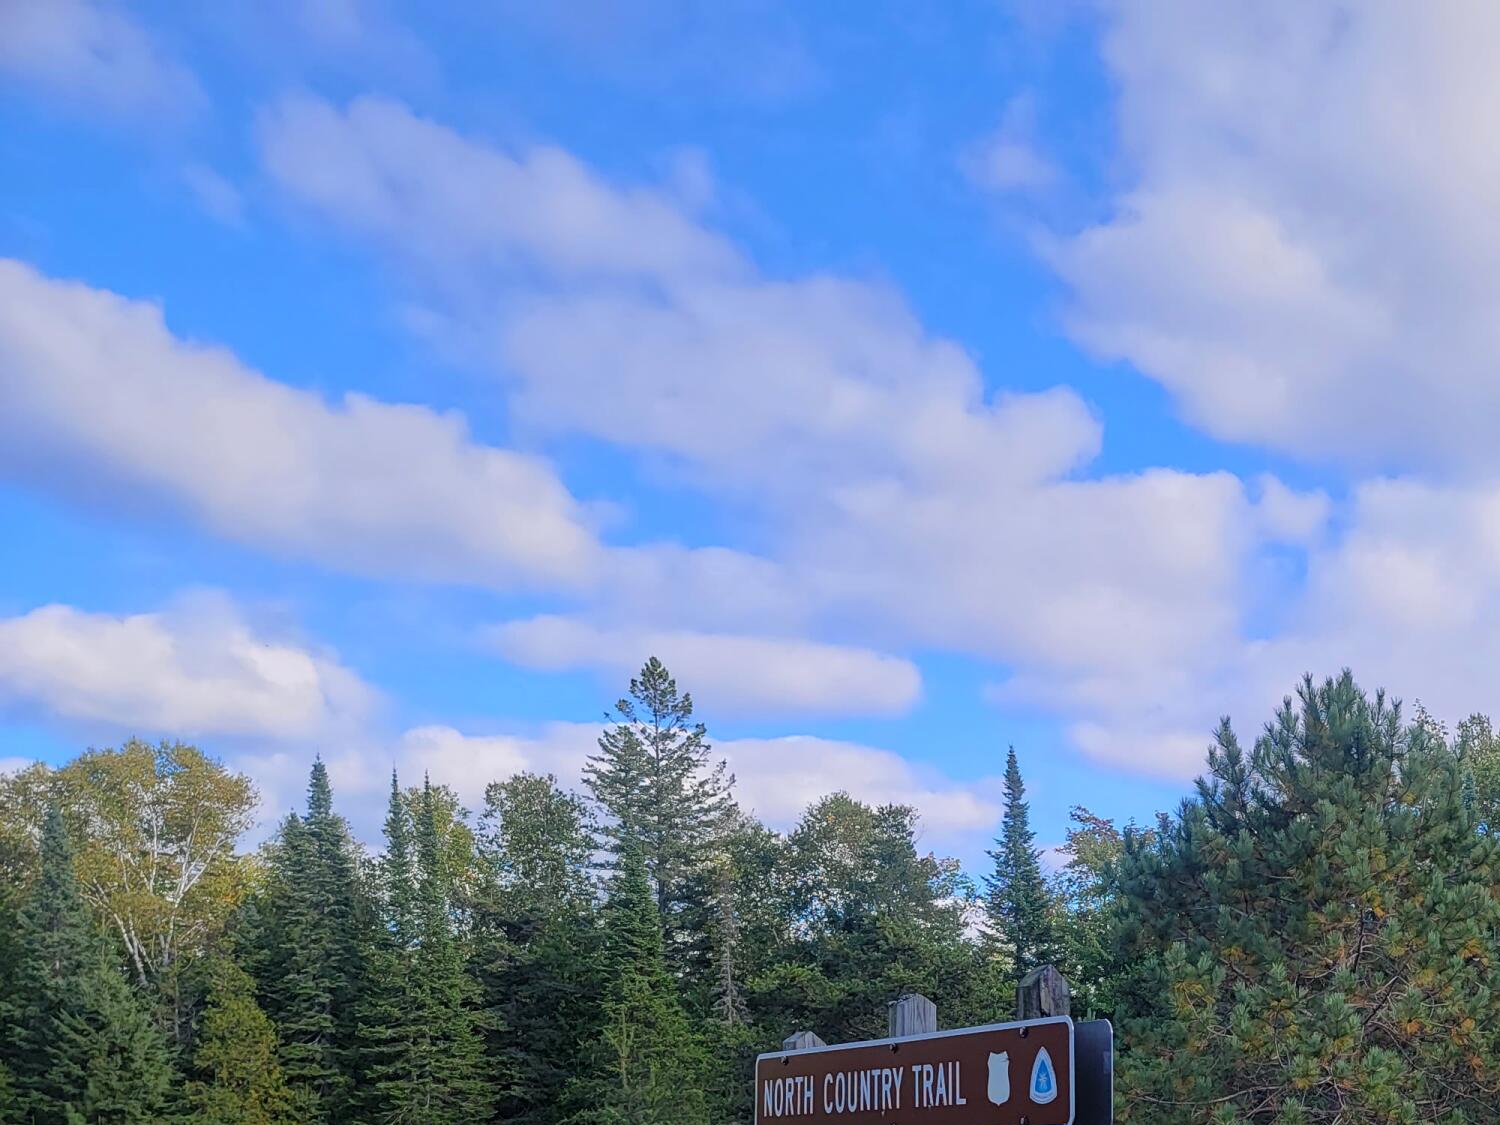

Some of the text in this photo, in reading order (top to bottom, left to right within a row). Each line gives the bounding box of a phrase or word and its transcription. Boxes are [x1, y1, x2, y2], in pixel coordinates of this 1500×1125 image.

[763, 1061, 967, 1117] NORTH COUNTRY TRAIL
